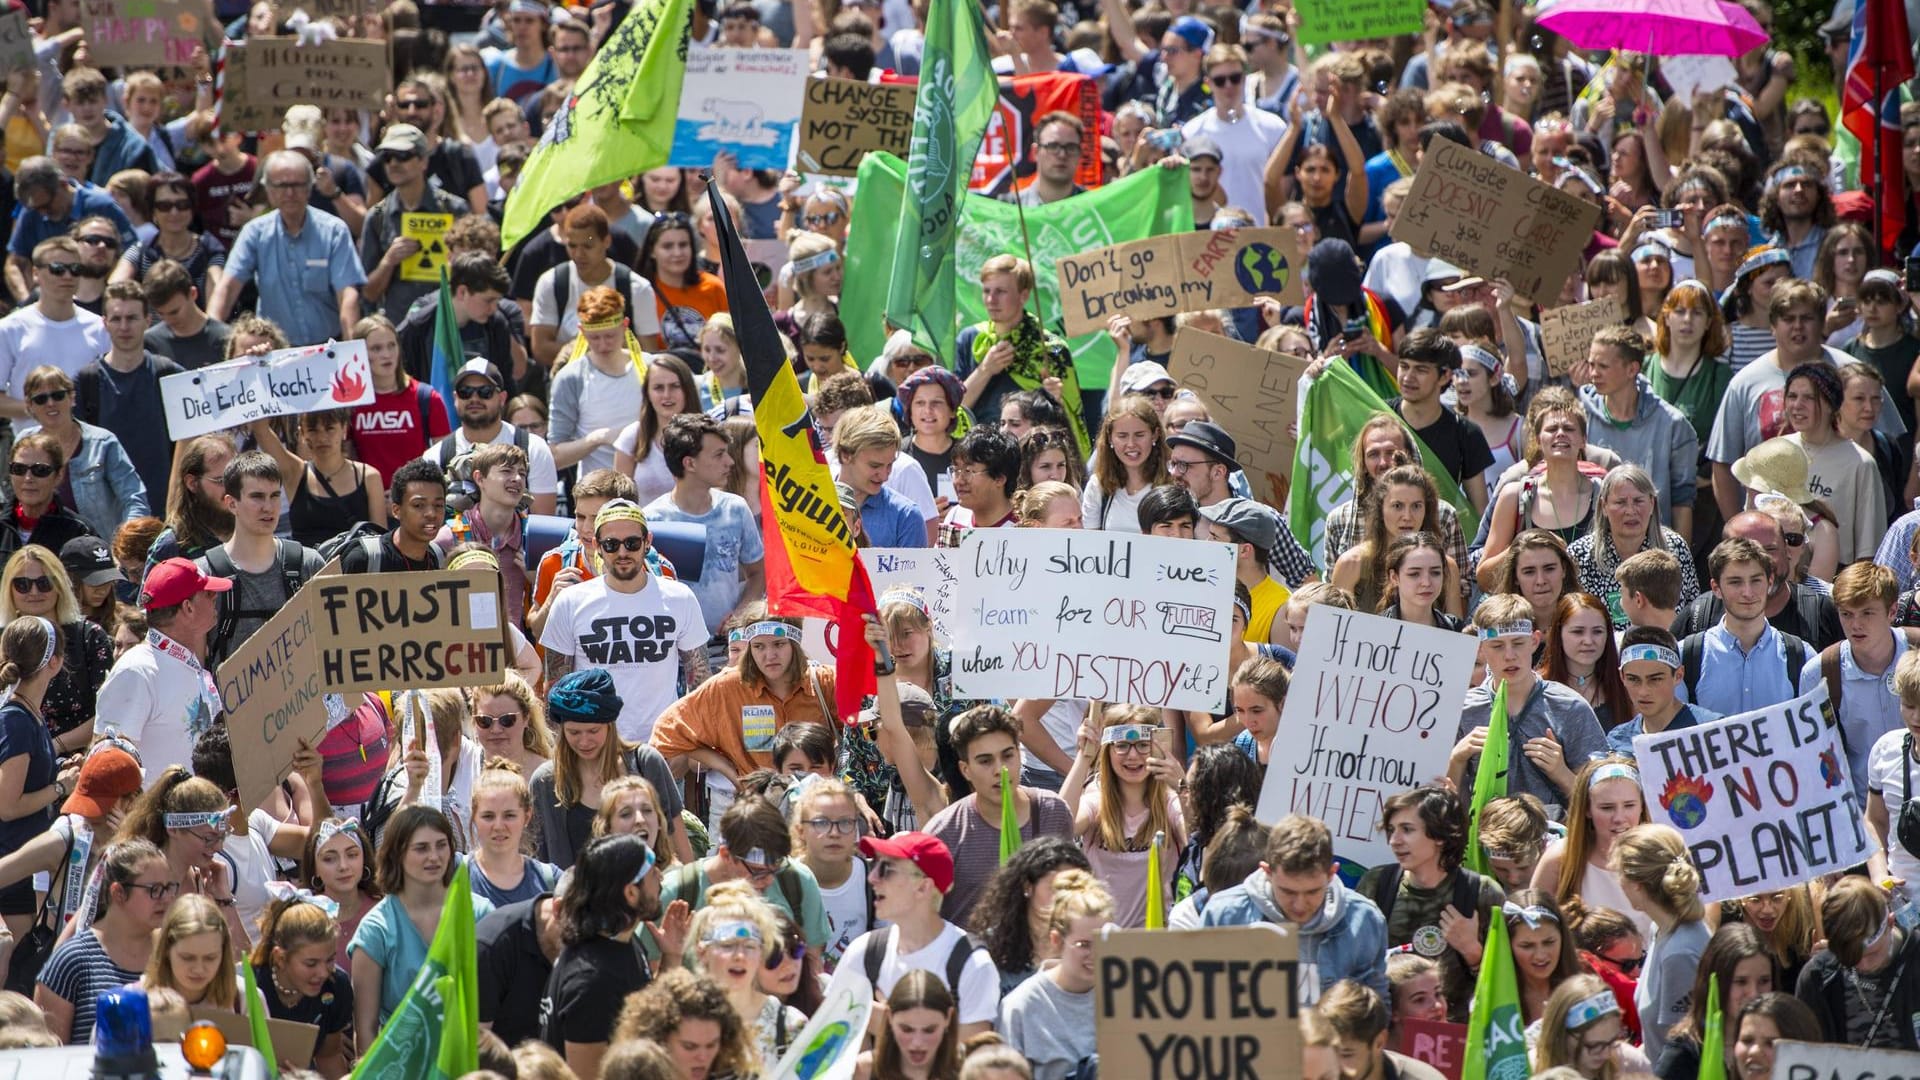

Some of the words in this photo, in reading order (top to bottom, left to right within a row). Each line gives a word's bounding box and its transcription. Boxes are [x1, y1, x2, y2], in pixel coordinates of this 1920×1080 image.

[808, 79, 904, 109] CHANGE
[808, 120, 858, 141] NOT
[876, 127, 915, 148] TH
[408, 217, 448, 230] STOP
[1062, 249, 1123, 289] Don't
[1130, 249, 1155, 280] go
[1081, 279, 1178, 321] breaking
[1180, 280, 1214, 302] my
[181, 396, 213, 421] Die
[215, 379, 257, 411] Erde
[356, 409, 415, 430] NASA
[1236, 351, 1297, 473] PLANET
[764, 456, 856, 551] elgium
[1808, 475, 1833, 497] the
[877, 554, 917, 574] Klima
[974, 538, 1028, 592] Why
[1045, 537, 1131, 580] should
[1166, 565, 1208, 583] we
[319, 579, 471, 636] FRUST
[579, 614, 677, 645] STOP
[1055, 594, 1093, 634] for
[1103, 597, 1149, 631] OUR
[1166, 607, 1214, 629] FUTURE
[323, 640, 504, 687] HERRSCHT
[580, 639, 676, 665] WARS
[961, 644, 1005, 674] when
[1010, 640, 1050, 673] YOU
[1053, 651, 1187, 708] DESTROY
[1180, 662, 1220, 696] it?
[1354, 624, 1404, 676] not
[1410, 649, 1445, 689] us,
[262, 671, 320, 745] COMING
[1314, 669, 1441, 740] WHO?
[1325, 733, 1370, 782] not
[1368, 755, 1421, 791] now,
[1650, 715, 1774, 783] THERE
[1784, 700, 1820, 749] IS
[1721, 759, 1799, 819] NO
[1688, 800, 1838, 896] PLANET
[1101, 956, 1299, 1019] PROTECT
[1138, 1033, 1261, 1080] YOUR
